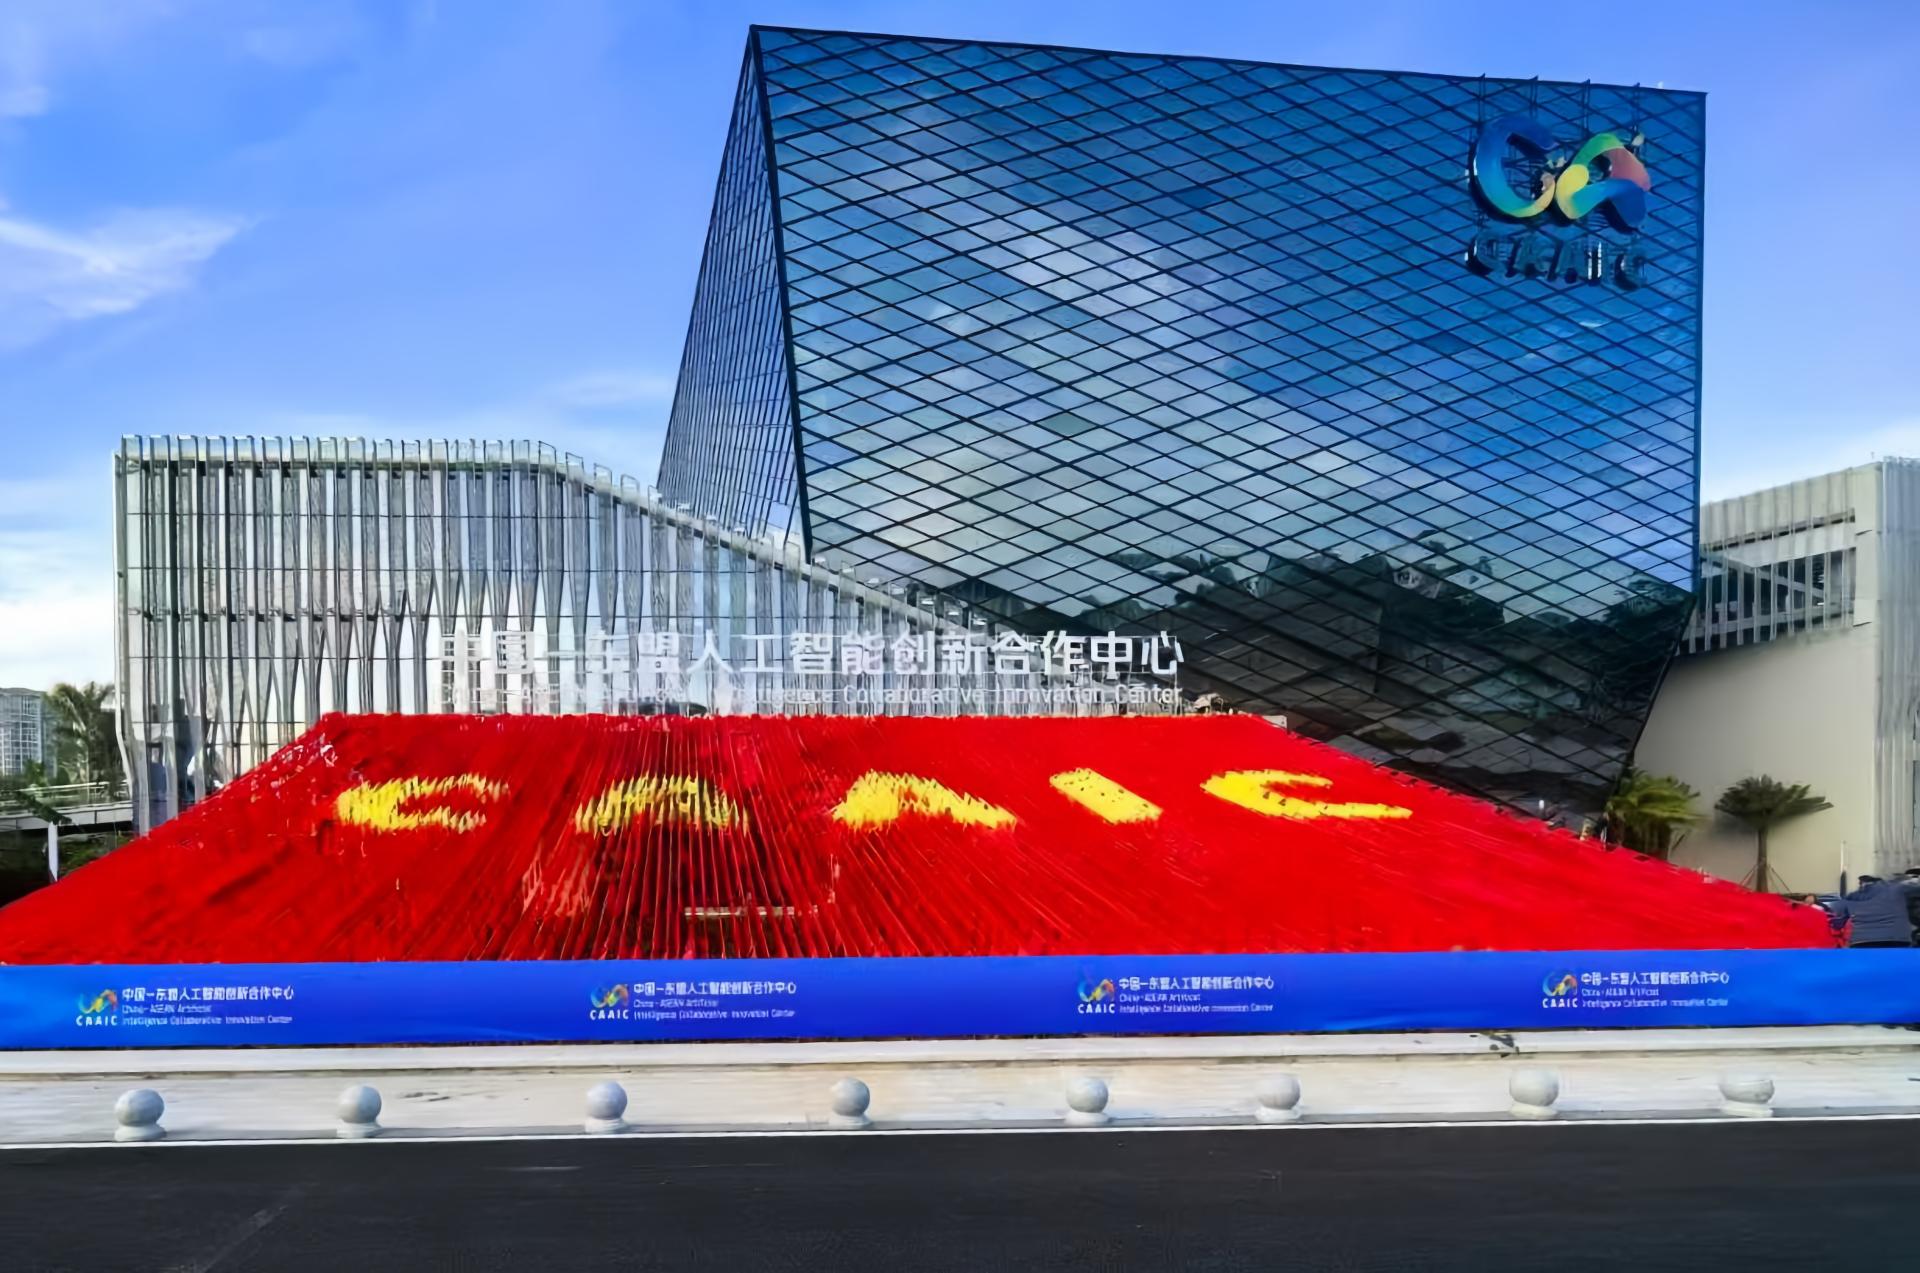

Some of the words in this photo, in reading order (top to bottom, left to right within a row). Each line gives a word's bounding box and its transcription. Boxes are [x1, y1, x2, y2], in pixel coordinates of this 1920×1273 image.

[1114, 683, 1184, 704] Center
[1078, 1003, 1116, 1014] CAAIC
[1542, 998, 1578, 1009] CAAIC
[590, 1009, 629, 1020] CAAIC
[76, 1015, 118, 1026] CAAIC
